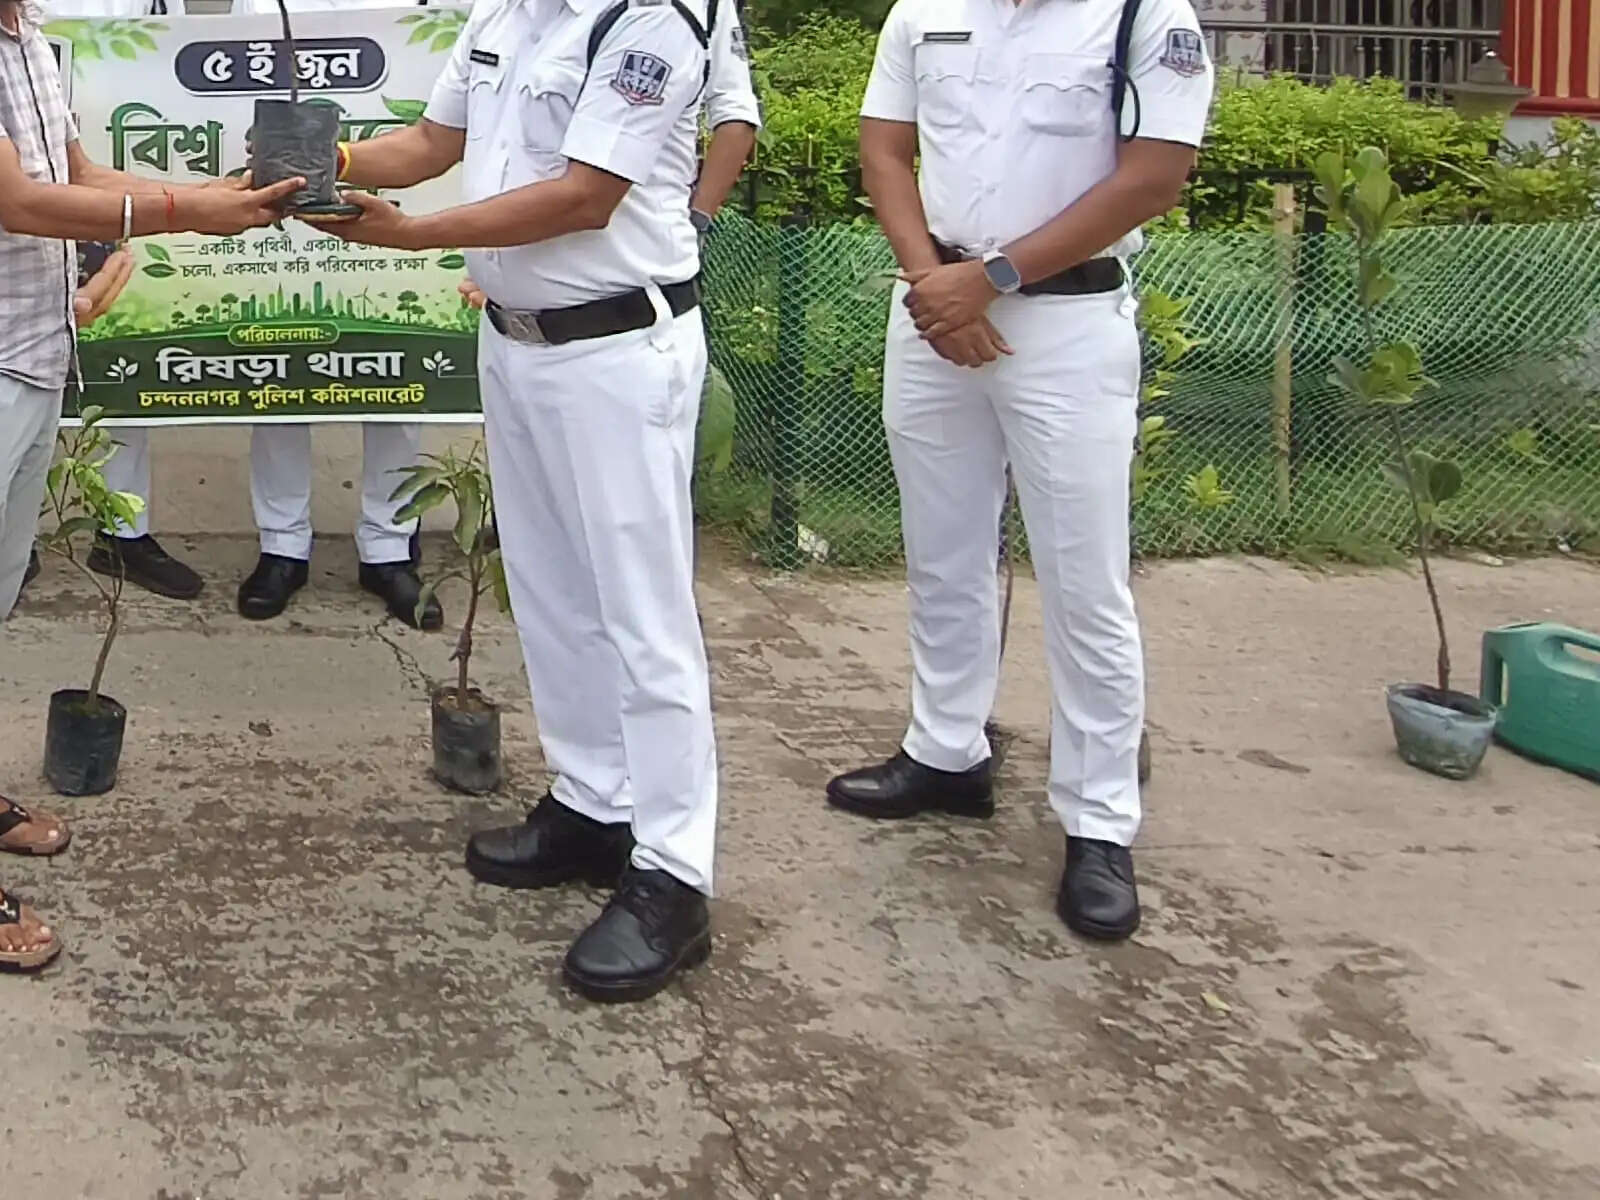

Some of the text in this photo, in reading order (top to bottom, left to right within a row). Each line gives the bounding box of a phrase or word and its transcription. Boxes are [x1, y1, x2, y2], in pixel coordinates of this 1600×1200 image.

[202, 42, 360, 87] ৫ ই জুন
[156, 347, 405, 384] রিষড়া থানা
[139, 383, 426, 410] চন্দননগর পুলিশ কমিশনারেট
